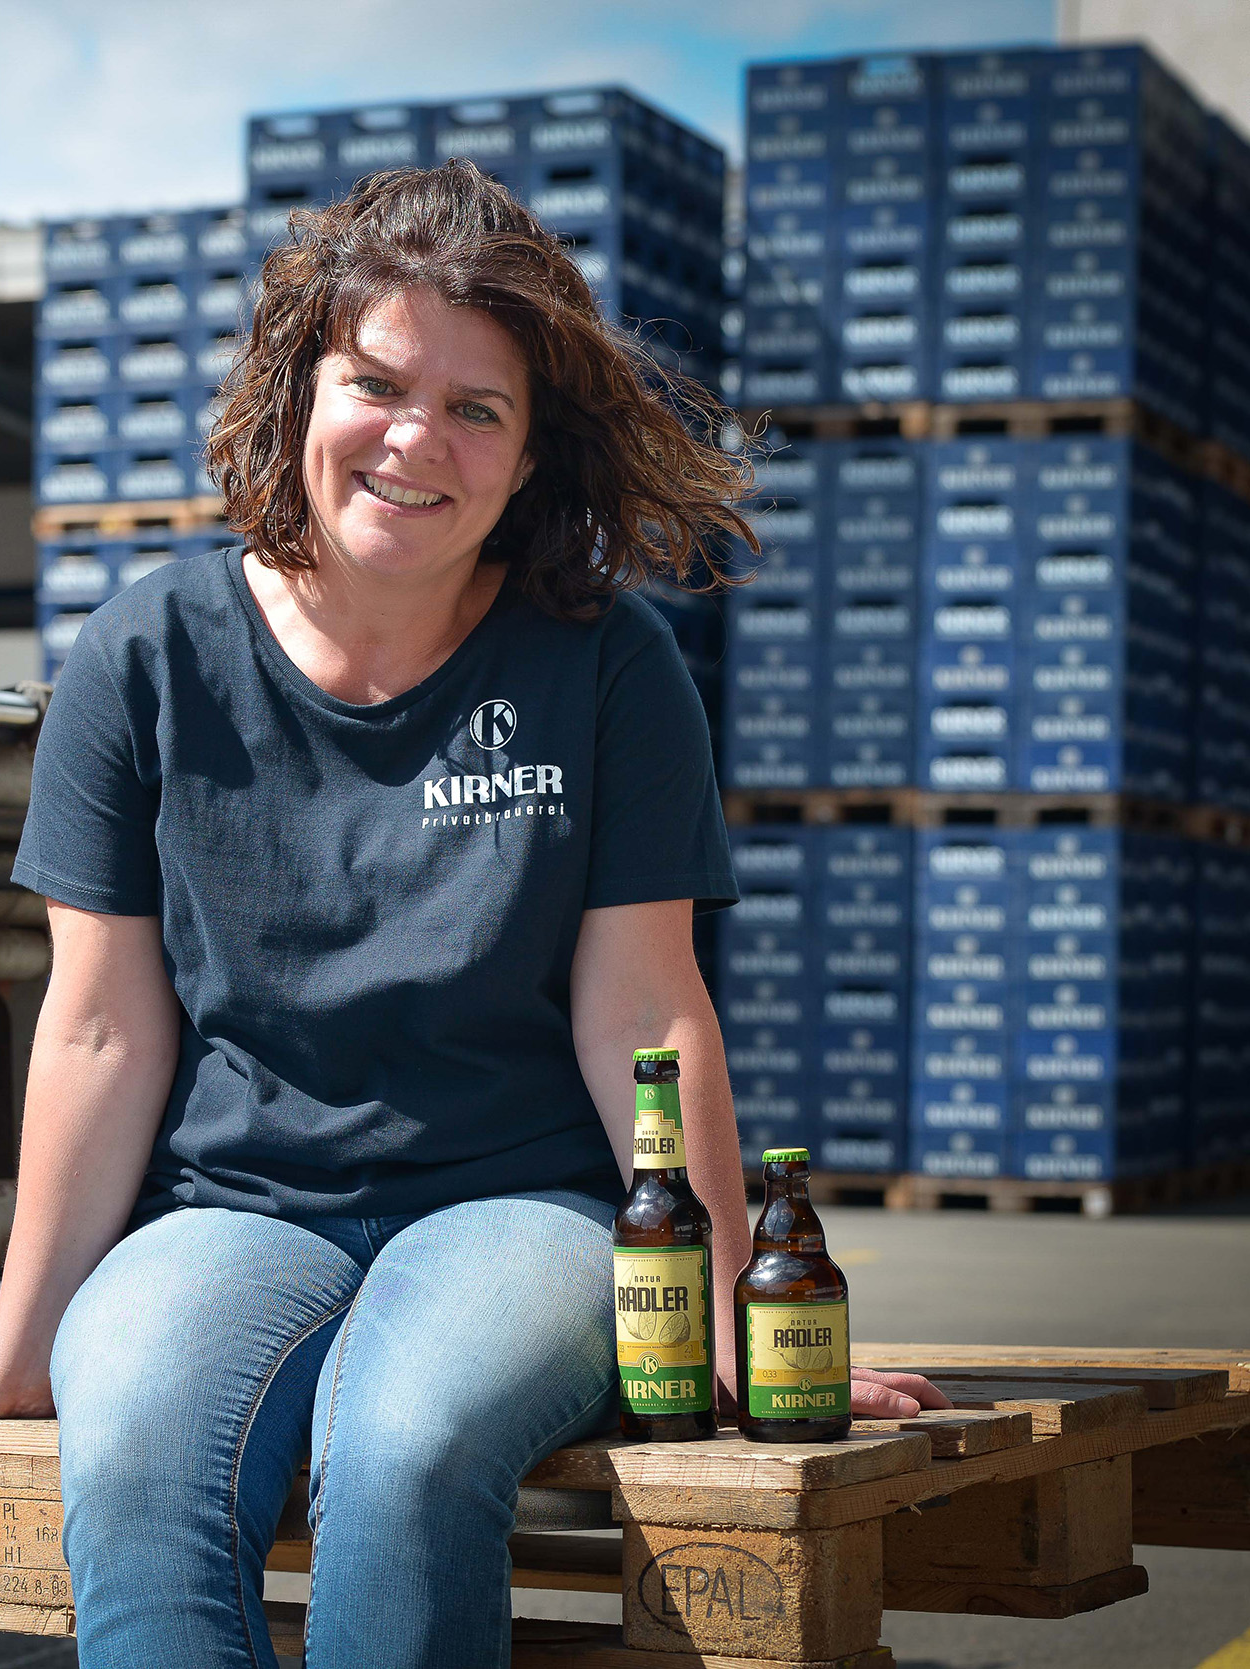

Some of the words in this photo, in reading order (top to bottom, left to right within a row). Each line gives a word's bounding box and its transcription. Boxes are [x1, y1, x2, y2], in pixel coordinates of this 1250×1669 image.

[470, 699, 517, 750] K
[424, 765, 563, 809] KIRNER
[618, 1286, 689, 1312] RADLER
[774, 1327, 832, 1348] RADLER
[641, 1356, 658, 1375] K
[620, 1379, 696, 1399] KIRNER
[771, 1393, 836, 1408] KIRNER
[3, 1503, 19, 1520] PL
[661, 1564, 761, 1621] EPAL
